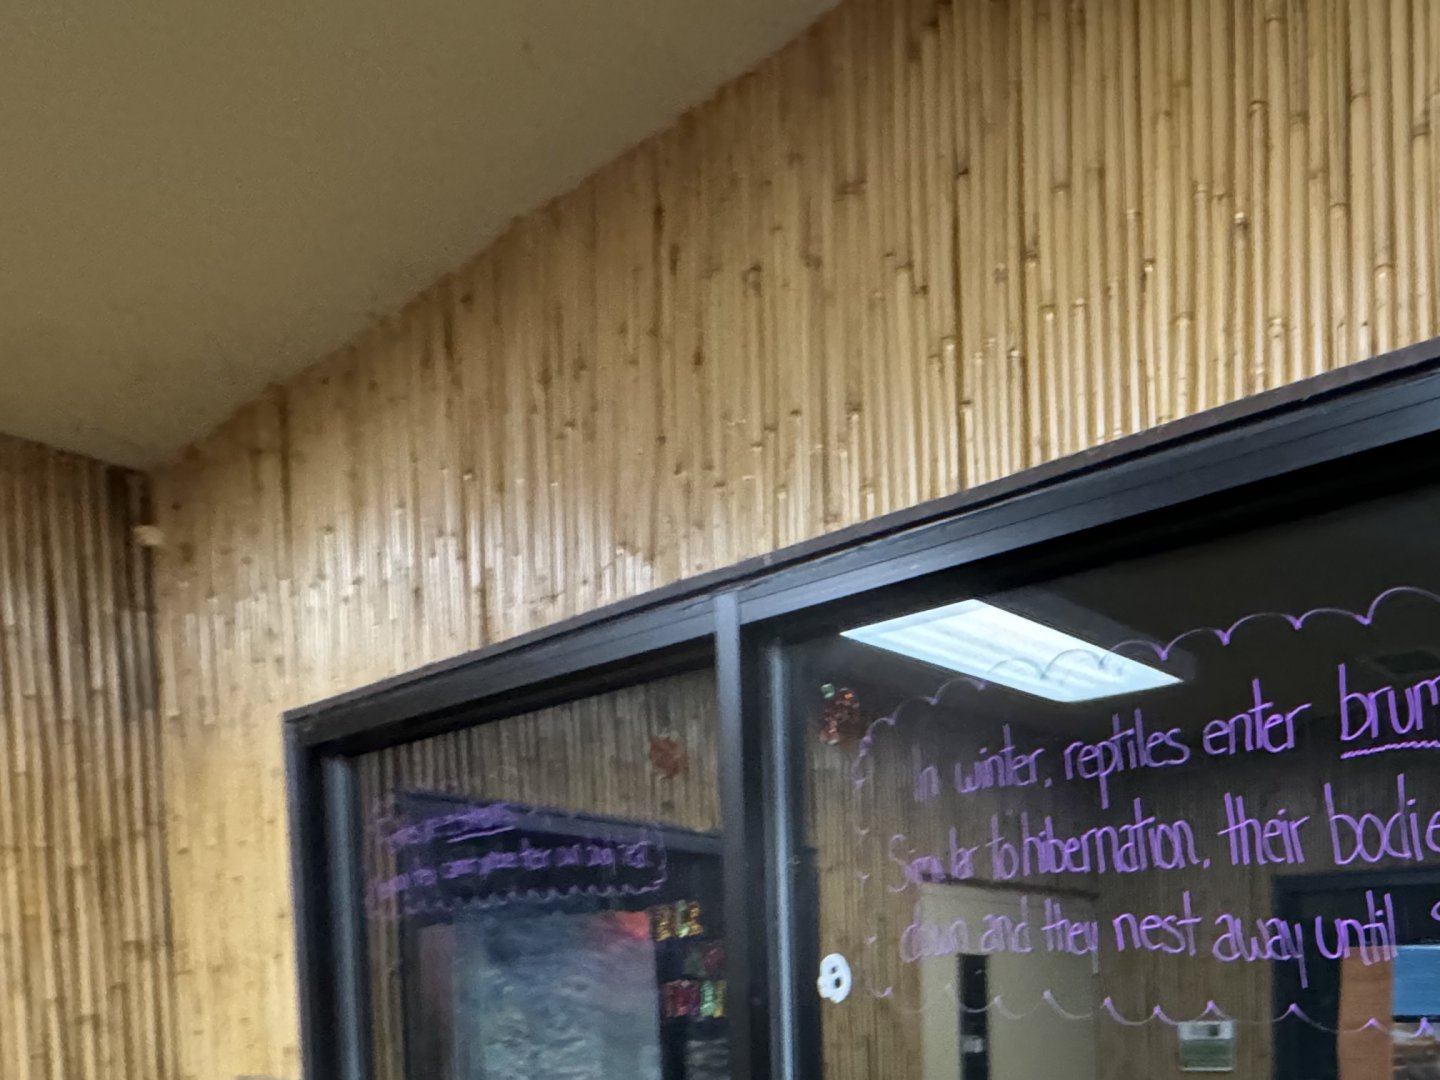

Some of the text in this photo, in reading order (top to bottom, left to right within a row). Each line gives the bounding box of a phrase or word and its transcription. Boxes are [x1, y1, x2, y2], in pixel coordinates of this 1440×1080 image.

[912, 742, 941, 801] In
[1064, 708, 1191, 809] reptiles
[1203, 678, 1312, 755] enter
[984, 811, 1019, 880] to
[1217, 792, 1311, 866] their
[899, 901, 971, 963] down
[981, 895, 1033, 954] and
[1041, 897, 1101, 975] they
[1112, 890, 1203, 956] nest
[1213, 914, 1309, 989] away
[1315, 890, 1398, 967] until
